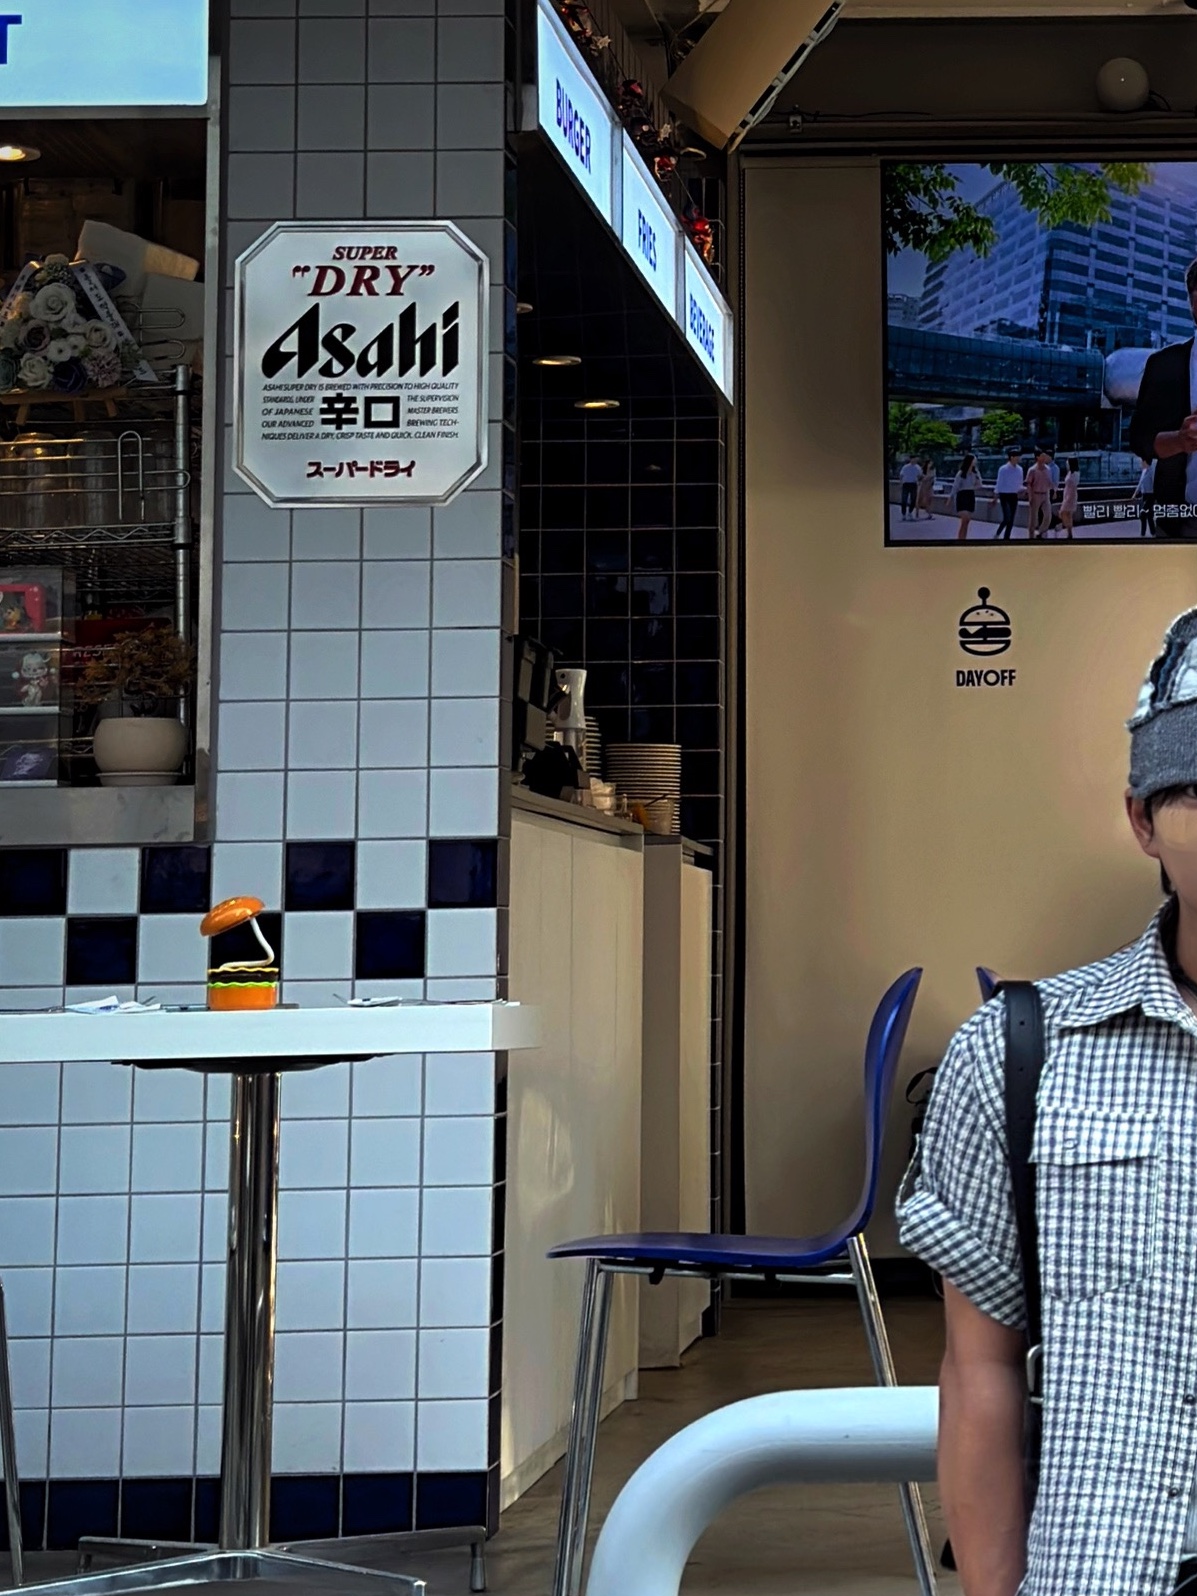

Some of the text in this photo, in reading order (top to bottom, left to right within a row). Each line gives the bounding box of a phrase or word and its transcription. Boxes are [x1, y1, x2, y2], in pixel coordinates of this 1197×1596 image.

[556, 78, 592, 174] BURGER
[638, 208, 657, 272] FRIES
[332, 246, 398, 260] SUPER
[261, 300, 459, 379] Asahi
[262, 408, 314, 416] OF JAPANESE
[319, 392, 400, 430] 辛口
[262, 420, 315, 428] OUR ADVANCED
[306, 460, 416, 478] スーパードライ
[1083, 504, 1110, 518] 빨리
[956, 669, 1016, 687] DAYOFF
